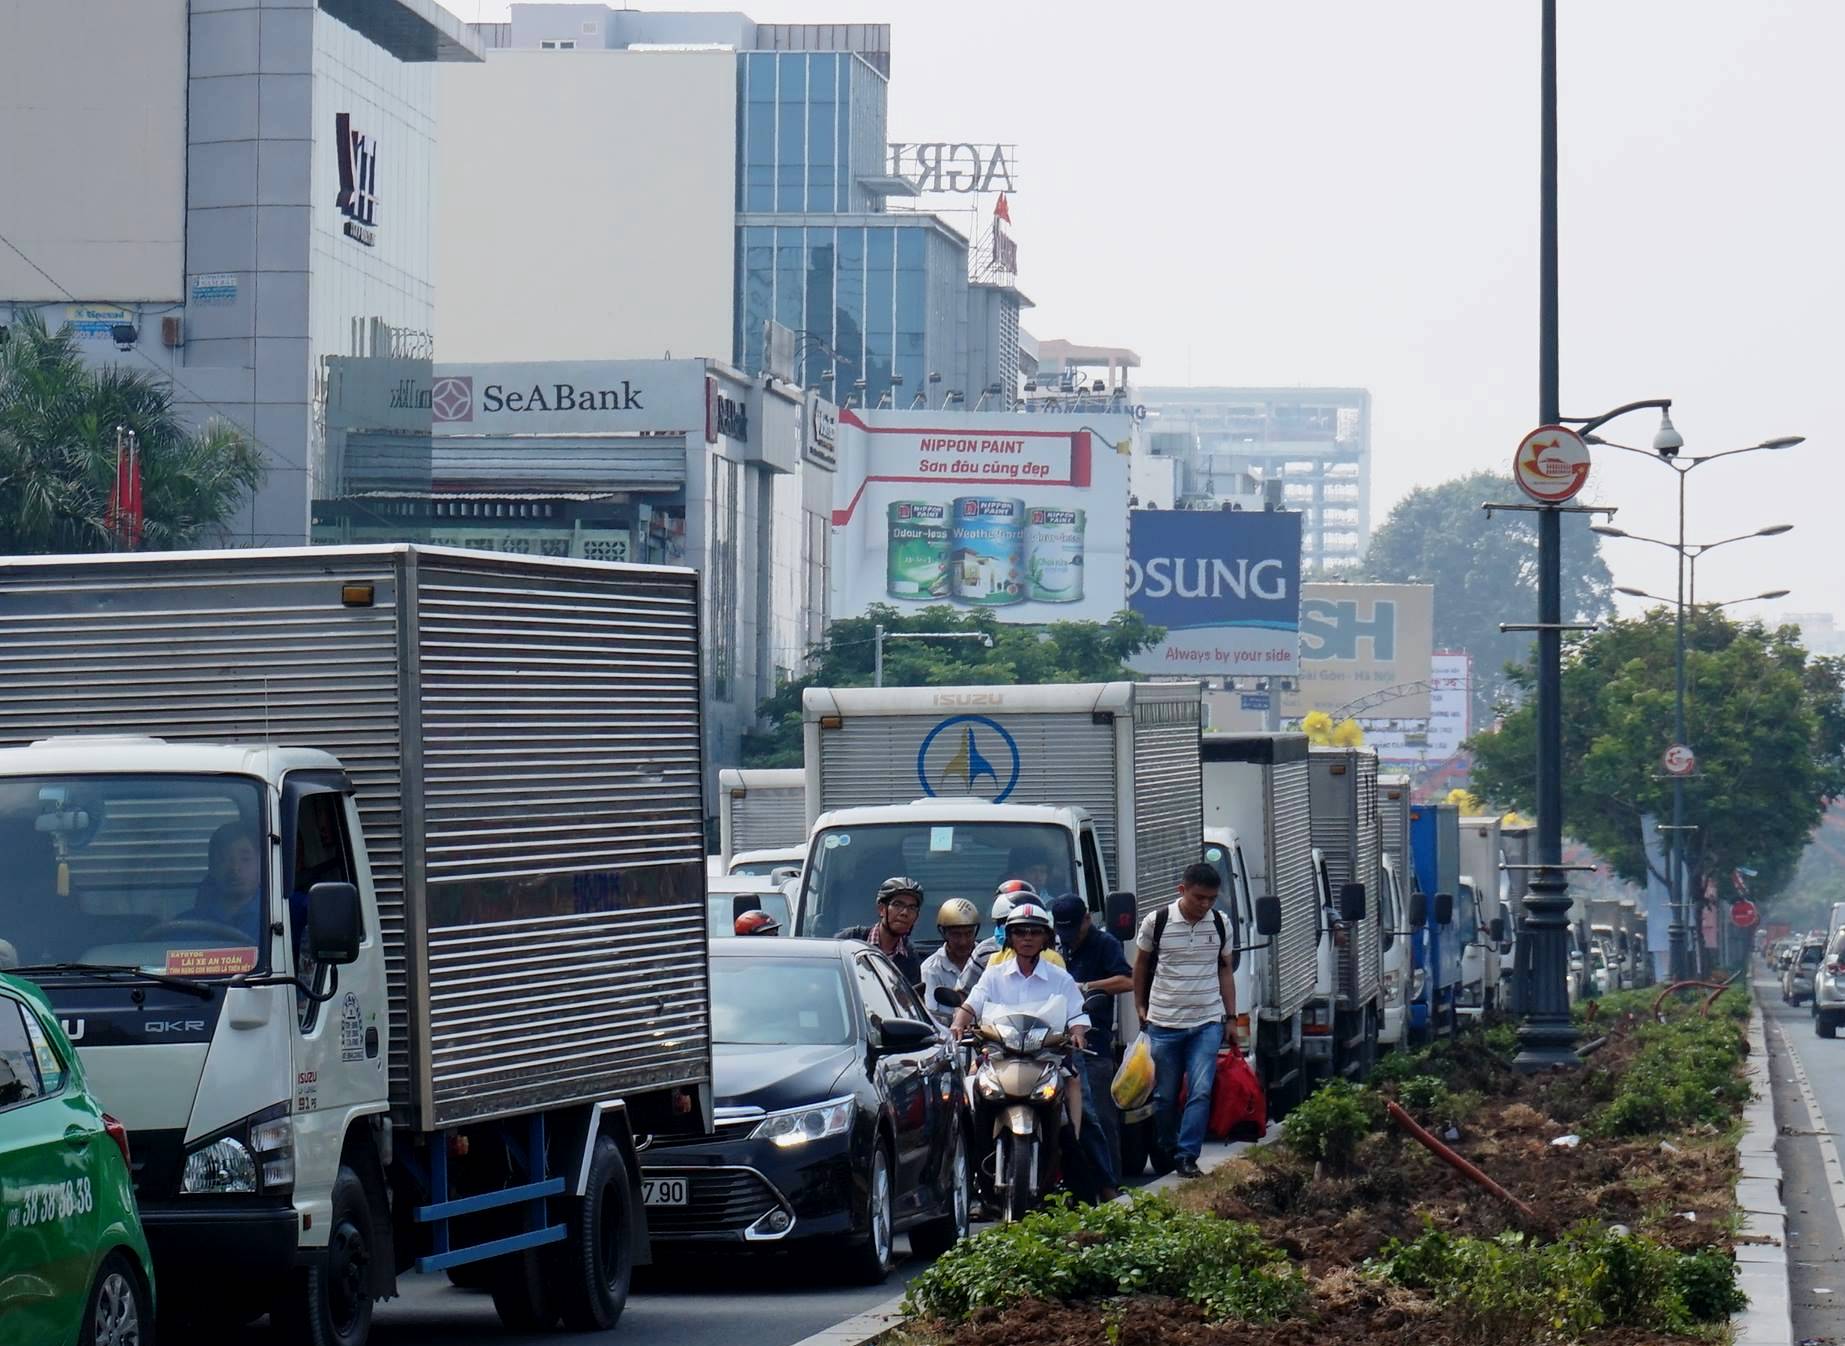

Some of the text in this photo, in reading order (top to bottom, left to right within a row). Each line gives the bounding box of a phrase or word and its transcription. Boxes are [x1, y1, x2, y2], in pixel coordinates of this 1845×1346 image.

[483, 381, 643, 412] SeABank
[920, 438, 1024, 454] NIPPON PAINT
[919, 459, 947, 473] Sơn
[894, 528, 947, 538] Odour-less
[1165, 647, 1291, 663] Always by your side
[933, 693, 1004, 705] ISUZU
[196, 958, 207, 966] XE
[145, 1020, 205, 1033] QKR
[298, 1072, 318, 1084] ISUZU
[23, 1189, 38, 1227] 38
[41, 1190, 56, 1223] 38
[77, 1176, 93, 1214] 38
